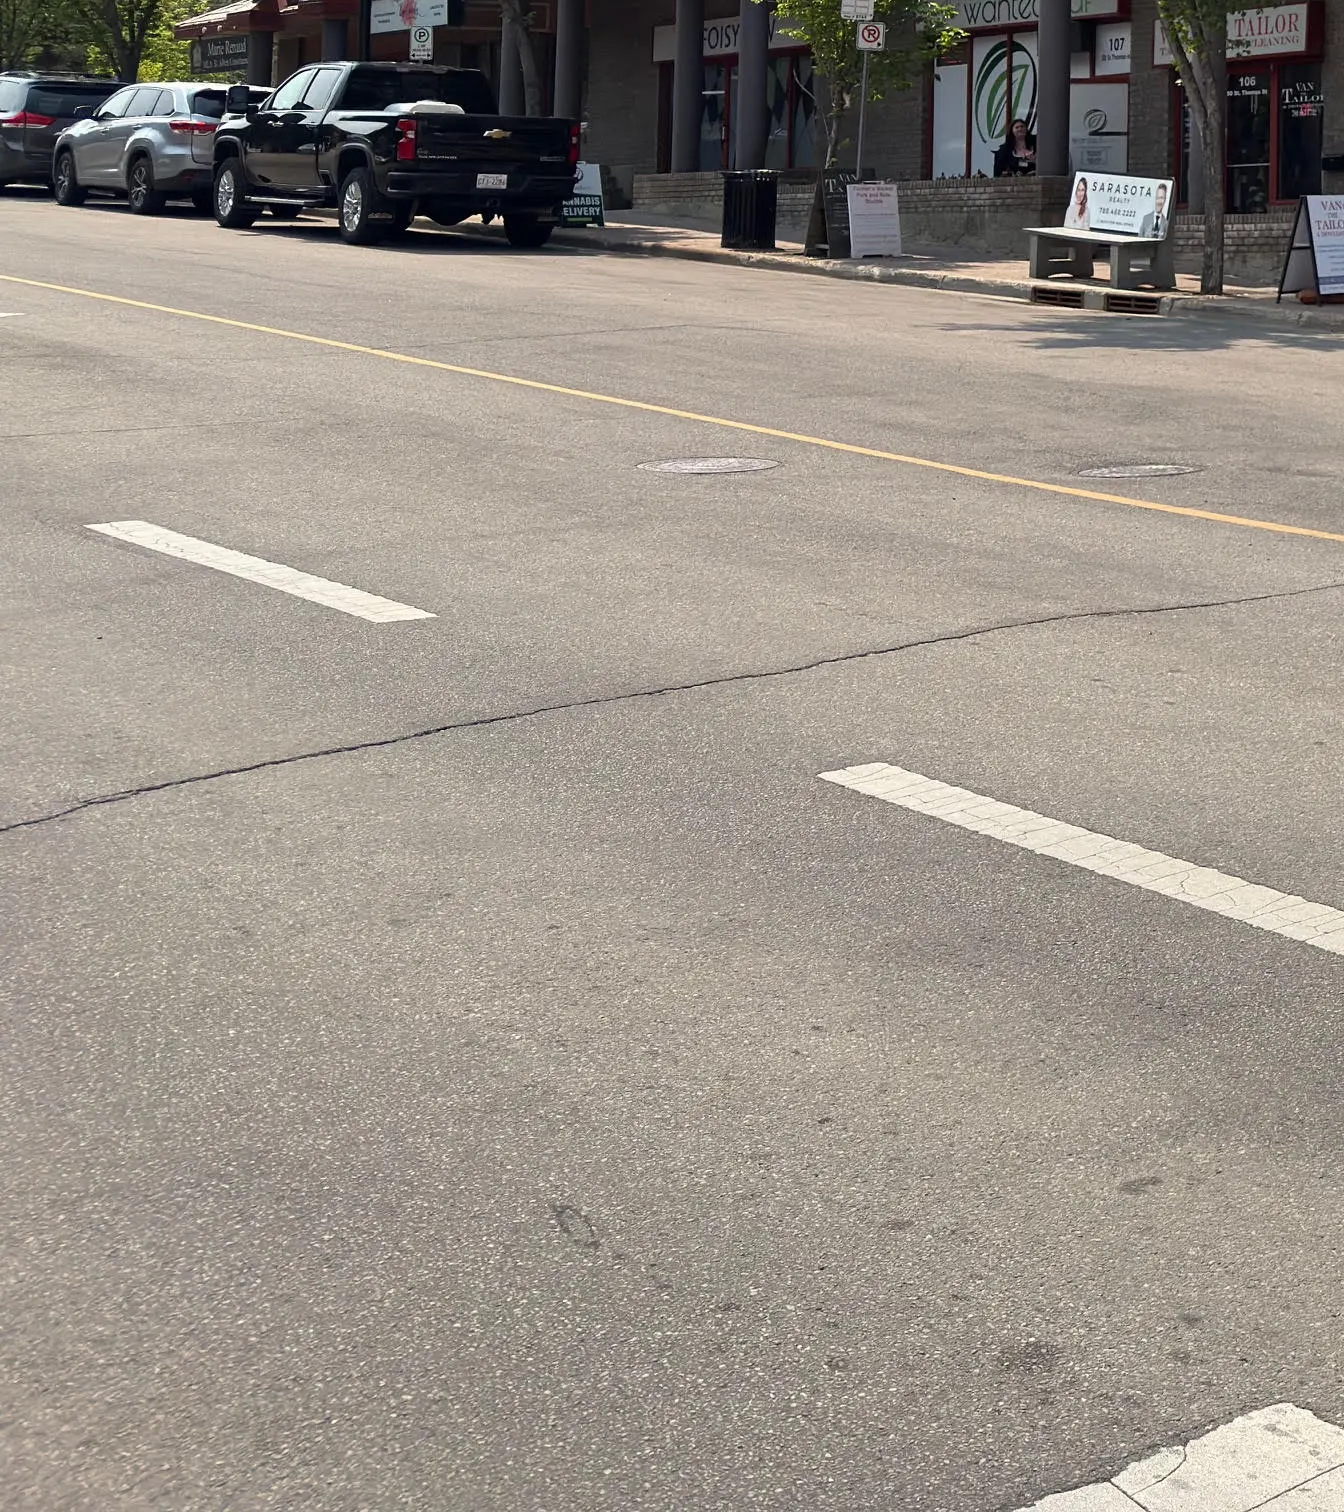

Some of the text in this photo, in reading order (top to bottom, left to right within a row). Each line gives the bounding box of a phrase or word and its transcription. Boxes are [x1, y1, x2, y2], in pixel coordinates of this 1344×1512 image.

[1234, 13, 1299, 38] TAILOR
[1109, 37, 1125, 51] 107
[1250, 35, 1299, 48] LEANING
[1239, 76, 1256, 87] 106
[1295, 81, 1314, 92] VAN
[1092, 181, 1152, 197] SARASOTA
[562, 196, 600, 206] ANNABIS
[1108, 196, 1130, 204] REALTY
[1321, 200, 1343, 211] VAN
[563, 206, 601, 216] ELIVERY
